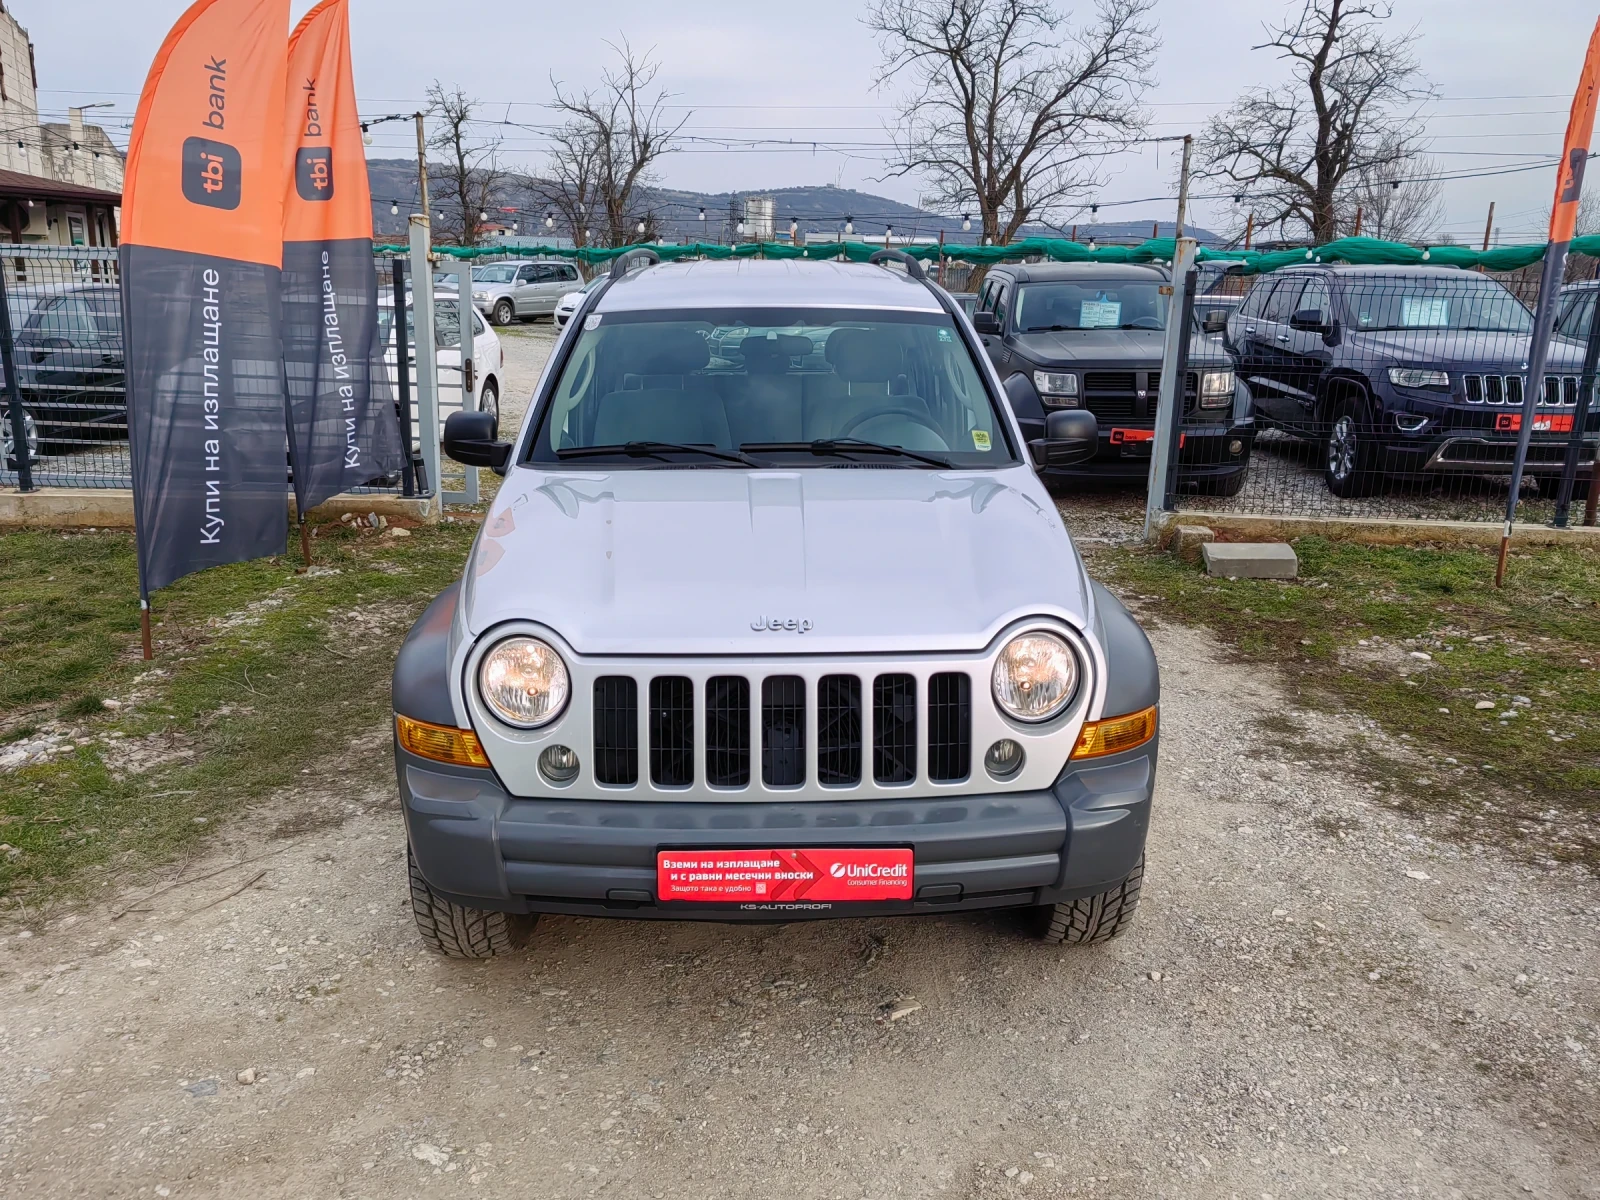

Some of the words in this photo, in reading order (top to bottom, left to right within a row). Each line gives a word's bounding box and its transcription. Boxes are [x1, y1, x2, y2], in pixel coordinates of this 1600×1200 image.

[202, 55, 227, 130] bank
[302, 77, 323, 137] bank
[200, 152, 224, 194] tbi
[306, 157, 329, 191] tbi
[321, 250, 348, 380] изплащане
[203, 268, 223, 430] изплащане
[339, 385, 355, 412] на
[205, 439, 220, 471] на
[344, 417, 361, 470] Купи
[200, 480, 225, 544] Купи
[750, 615, 814, 634] Jeep
[663, 859, 698, 869] Вземи
[700, 860, 714, 869] на
[716, 859, 780, 869] изплащане
[689, 873, 723, 882] равни
[725, 872, 772, 880] месечни
[774, 871, 814, 880] вноски
[847, 863, 908, 877] UniCredit
[670, 884, 699, 893] Защото
[724, 884, 752, 893] удобно
[879, 879, 908, 887] Financing
